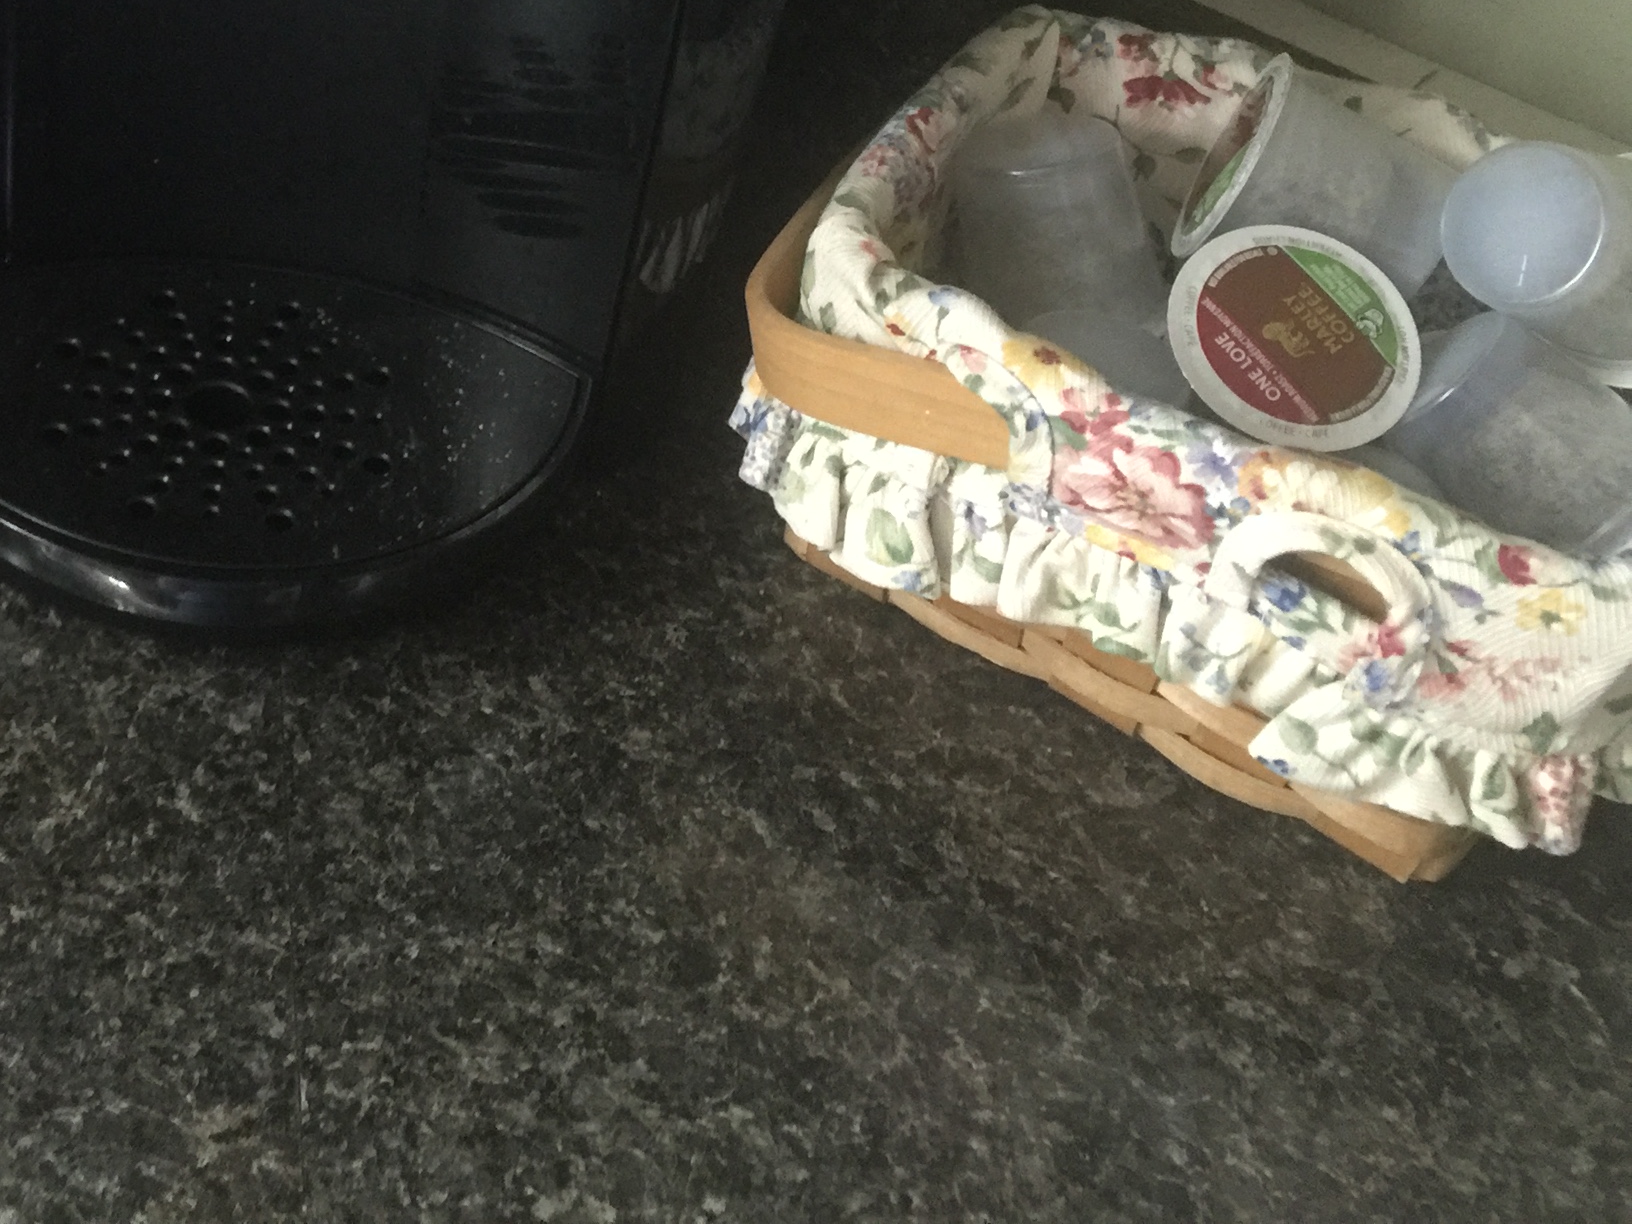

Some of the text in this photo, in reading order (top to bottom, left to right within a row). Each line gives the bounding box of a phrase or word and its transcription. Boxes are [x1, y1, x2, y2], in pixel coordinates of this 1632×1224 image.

[1282, 294, 1343, 354] MARLEY
[1300, 285, 1355, 343] COFFEE
[1215, 332, 1281, 401] ONE LOVE
